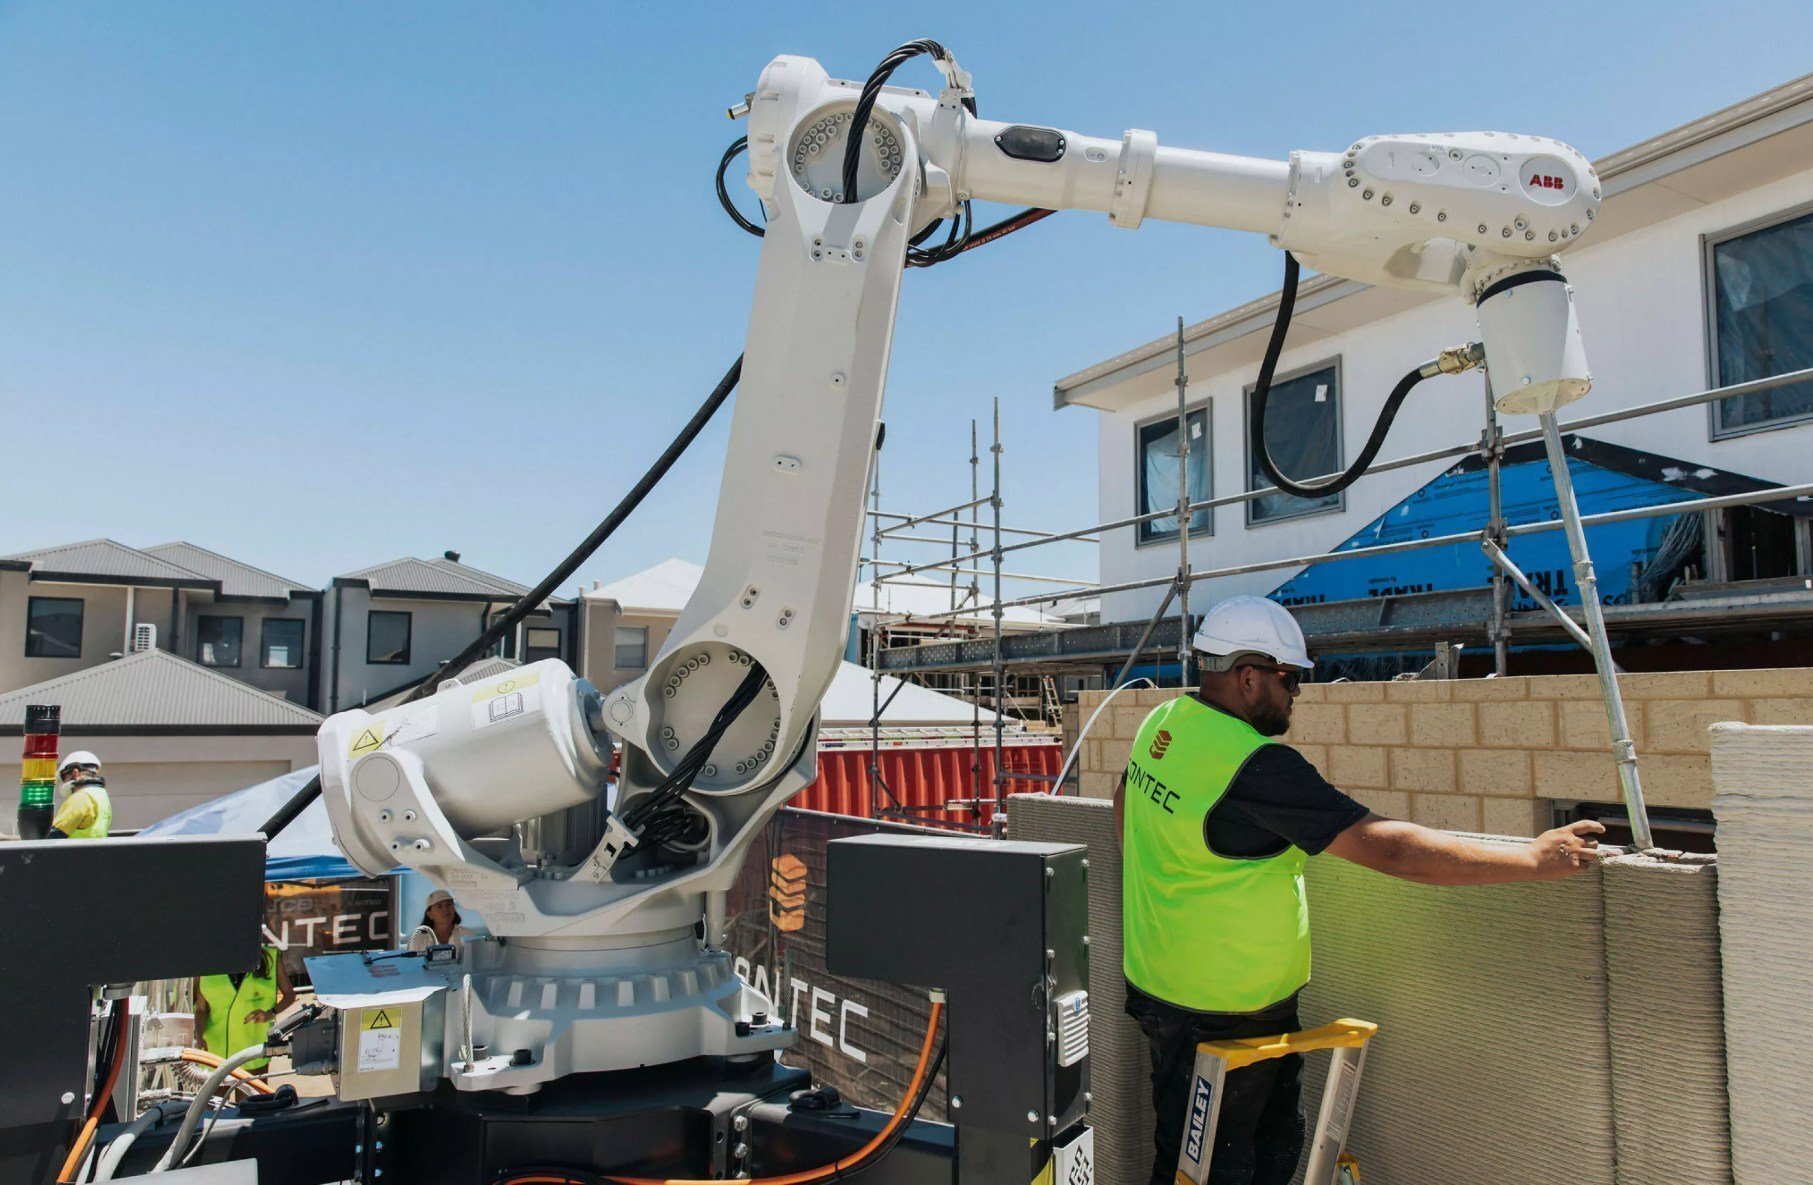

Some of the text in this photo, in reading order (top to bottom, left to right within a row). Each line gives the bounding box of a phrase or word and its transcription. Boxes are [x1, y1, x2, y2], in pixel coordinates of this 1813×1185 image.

[1529, 174, 1564, 190] ABB
[1127, 758, 1181, 814] ONTEC
[266, 898, 313, 913] JCB
[1187, 1078, 1211, 1162] BAILEY
